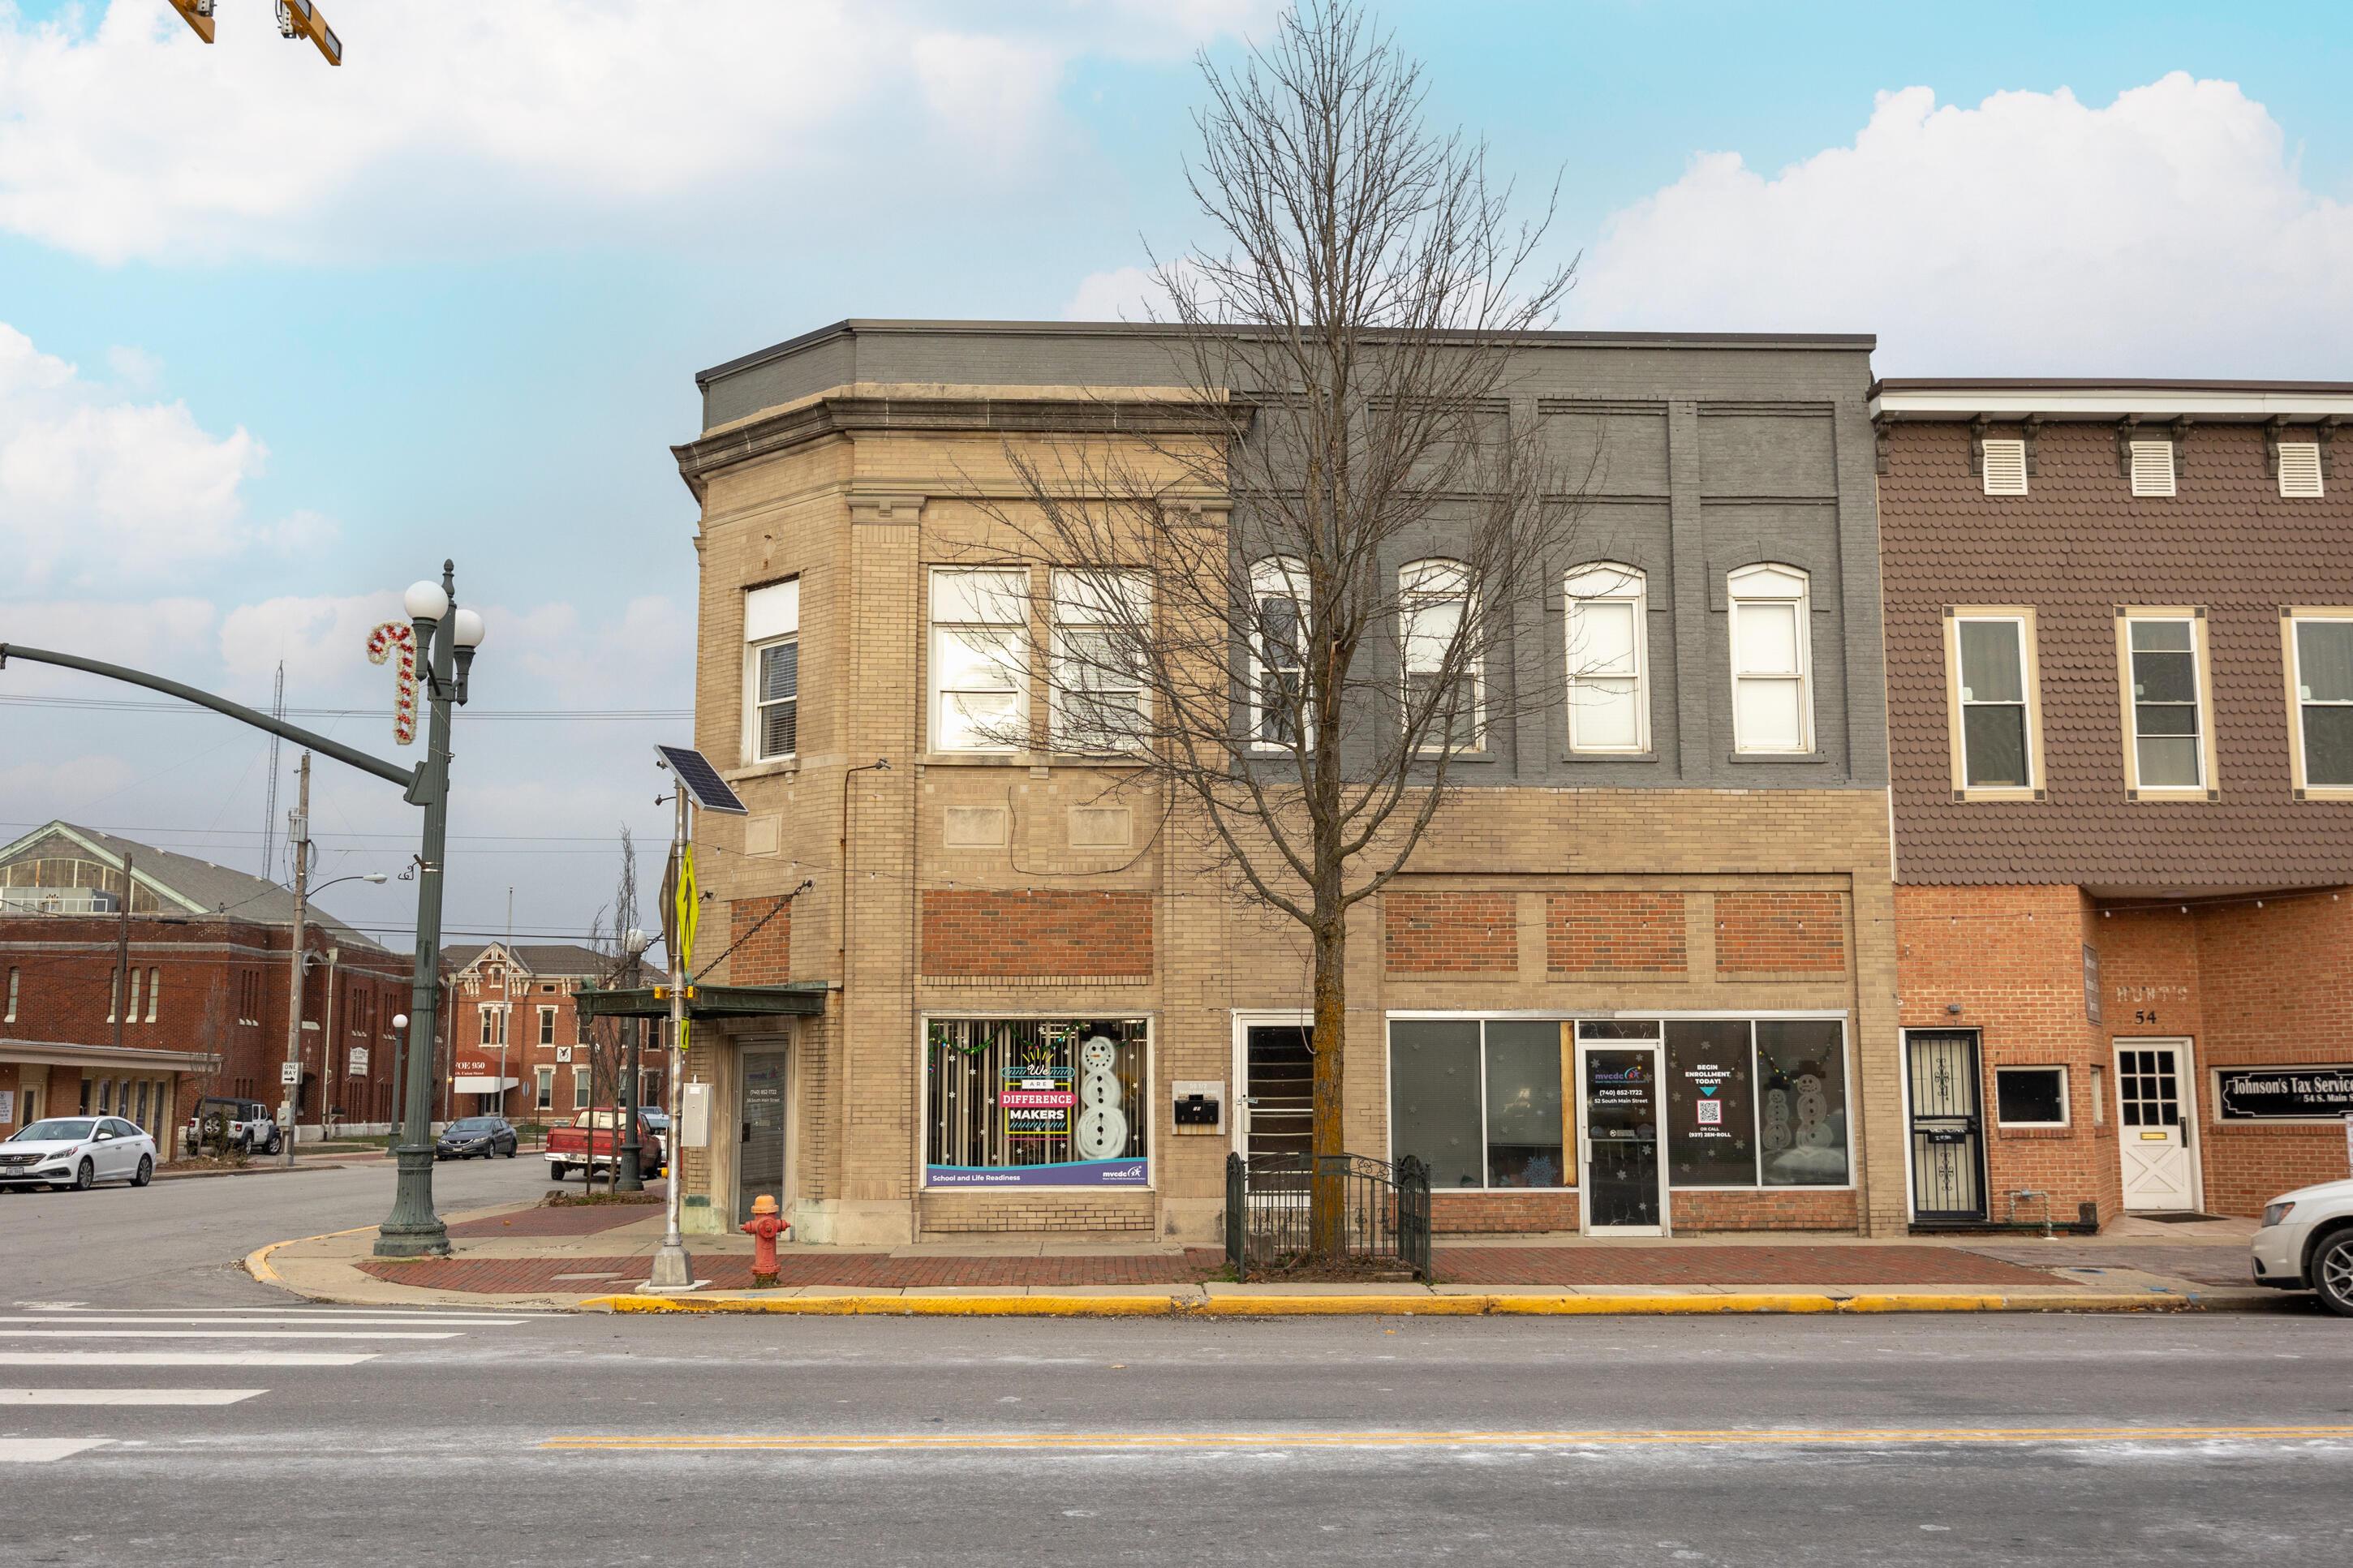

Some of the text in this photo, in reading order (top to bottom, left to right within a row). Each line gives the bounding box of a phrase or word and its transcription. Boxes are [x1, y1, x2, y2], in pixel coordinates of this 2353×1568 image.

[2135, 1010, 2157, 1024] 54
[1027, 1063, 1050, 1076] We
[2233, 1077, 2288, 1094] Johnson's
[2290, 1077, 2312, 1093] Tax
[1003, 1094, 1072, 1104] DIFFERENCE
[2303, 1094, 2314, 1102] 54
[2316, 1094, 2325, 1102] S.
[1010, 1110, 1065, 1119] MAKERS
